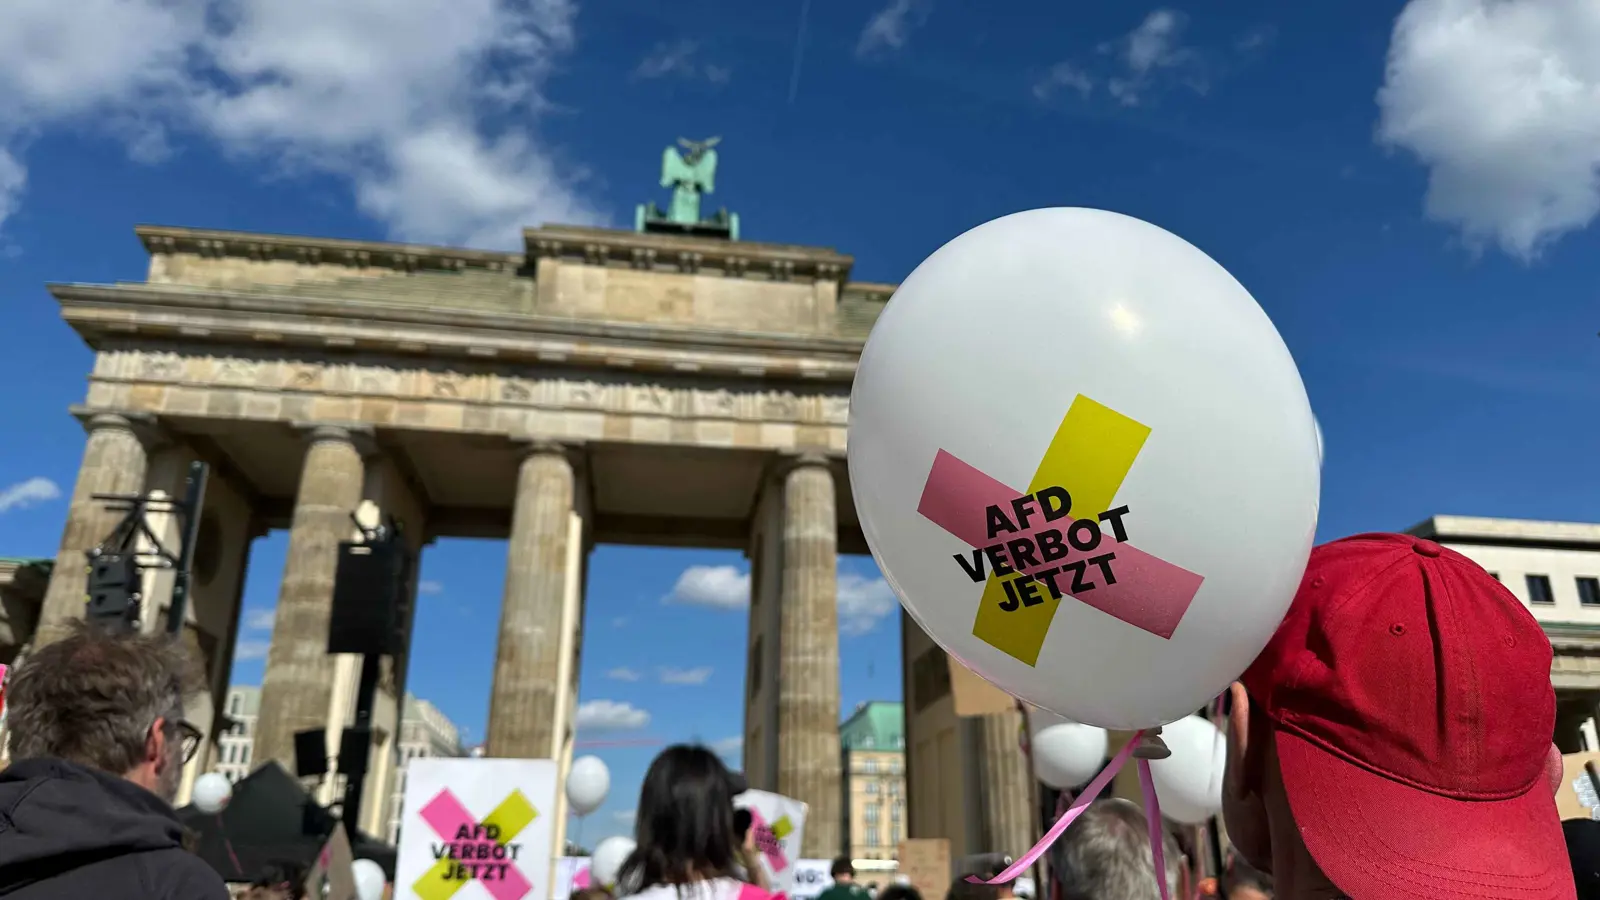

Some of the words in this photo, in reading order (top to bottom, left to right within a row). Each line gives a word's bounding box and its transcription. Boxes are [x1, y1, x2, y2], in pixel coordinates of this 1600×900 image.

[985, 486, 1072, 559] AFD
[952, 505, 1130, 583] VERBOT
[998, 552, 1117, 612] JETZT
[455, 823, 500, 840] AFD
[432, 843, 522, 861] VERBOT
[441, 863, 510, 880] JETZT
